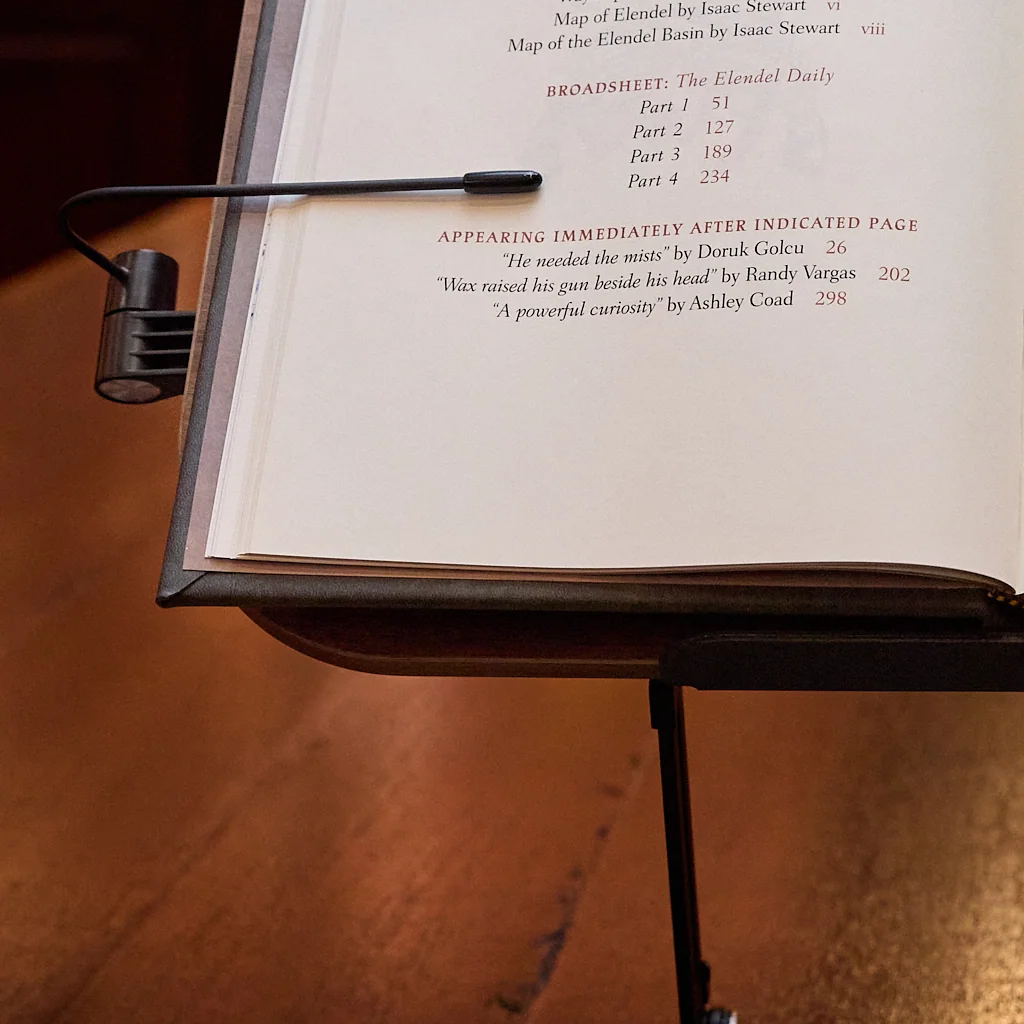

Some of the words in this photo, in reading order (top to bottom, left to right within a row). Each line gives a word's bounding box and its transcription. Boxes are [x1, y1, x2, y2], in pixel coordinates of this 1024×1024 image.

[553, 11, 589, 29] Map
[593, 7, 611, 24] of
[613, 2, 673, 22] Elendel
[677, 2, 696, 21] by
[700, 1, 741, 16] Isaac
[507, 37, 543, 56] Map
[547, 34, 566, 51] of
[568, 33, 593, 49] the
[597, 27, 657, 47] Elendel
[661, 26, 704, 42] Basin
[709, 23, 728, 42] by
[733, 22, 774, 37] Isaac
[778, 20, 841, 35] Stewart
[860, 22, 885, 36] viii
[546, 77, 669, 98] BROADSHEET:
[676, 72, 708, 89] The
[713, 67, 781, 86] Elendel
[786, 66, 835, 87] Daily
[639, 99, 674, 115] Part
[681, 97, 689, 112] 1
[712, 95, 729, 110] 51
[632, 124, 666, 140] Part
[672, 122, 683, 137] 2
[706, 119, 735, 135] 127
[629, 148, 664, 164] Part
[670, 146, 680, 161] 3
[703, 144, 733, 160] 189
[627, 173, 662, 189] Part
[668, 171, 679, 186] 4
[699, 168, 730, 185] 234
[436, 230, 545, 244] APPEARING
[553, 222, 684, 243] IMMEDIATELY
[688, 219, 747, 235] AFTER
[754, 216, 861, 231] INDICATED
[868, 217, 918, 232] PAGE
[535, 249, 591, 268] needed
[594, 248, 619, 265] the
[673, 244, 693, 265] by
[697, 240, 750, 259] Doruk
[754, 239, 804, 256] Golcu
[825, 239, 847, 255] 26
[481, 277, 529, 293] raised
[532, 276, 555, 293] his
[557, 281, 589, 297] gun
[593, 272, 641, 291] beside
[645, 271, 668, 288] his
[721, 267, 741, 288] by
[745, 264, 799, 285] Randy
[802, 264, 857, 284] Vargas
[878, 266, 911, 283] 202
[514, 300, 586, 323] powerful
[667, 295, 686, 316] by
[688, 292, 745, 313] Ashley
[749, 289, 794, 308] Coad
[814, 290, 847, 306] 298
